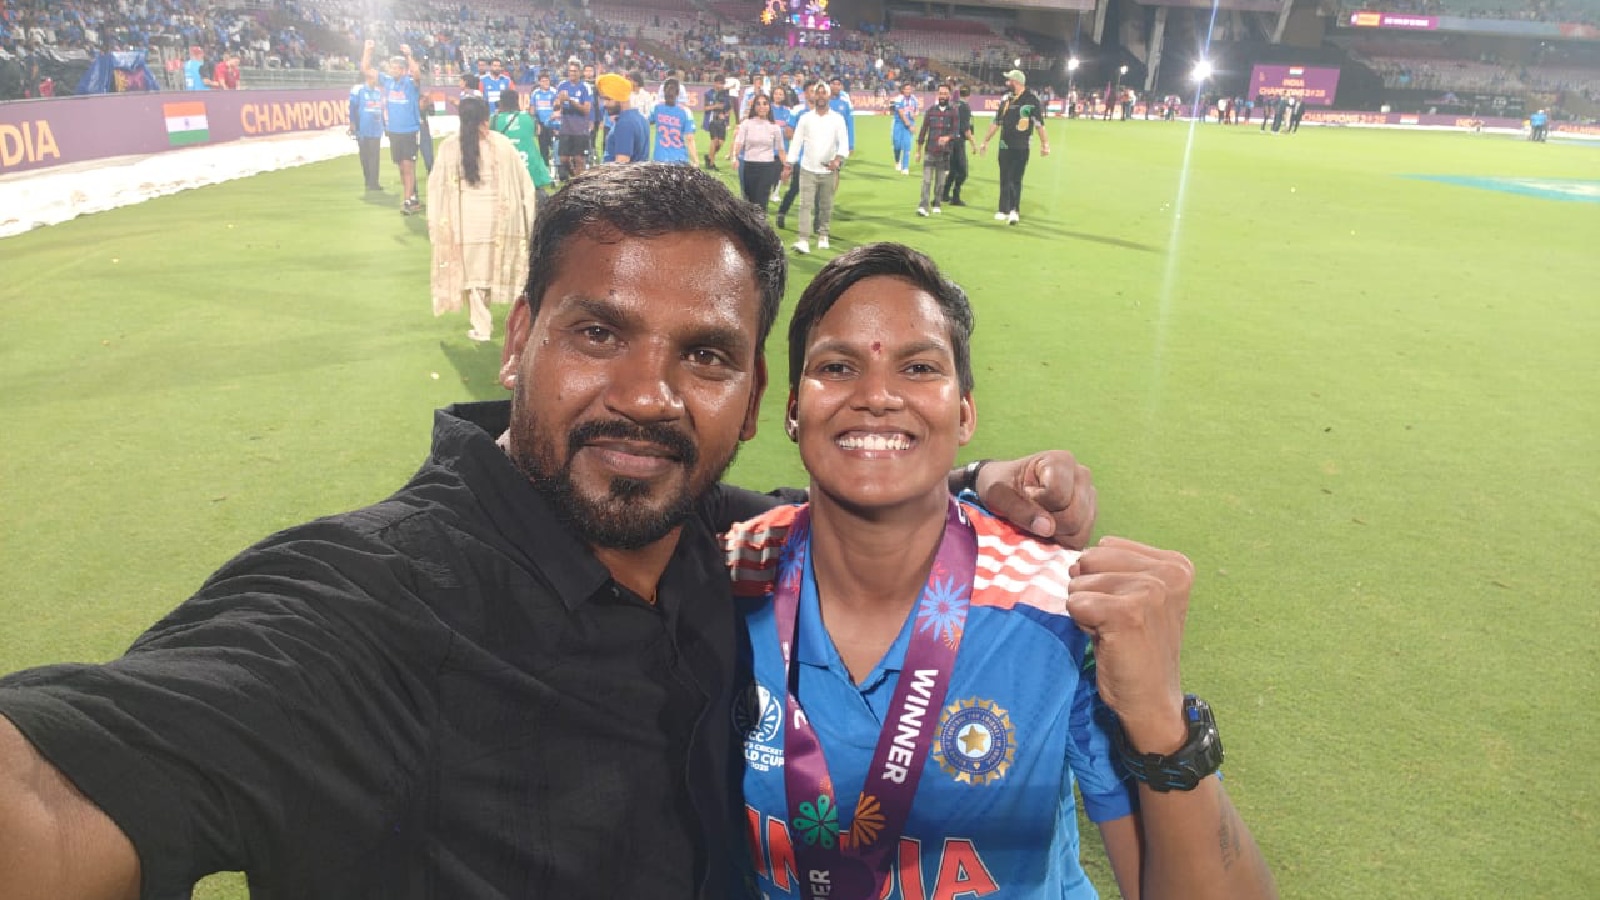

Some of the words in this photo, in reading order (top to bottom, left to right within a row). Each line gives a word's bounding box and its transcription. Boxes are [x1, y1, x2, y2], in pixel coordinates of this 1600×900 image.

[658, 125, 683, 149] 33
[881, 669, 939, 784] WINNER
[761, 754, 785, 766] CUP
[744, 804, 1000, 900] INIA
